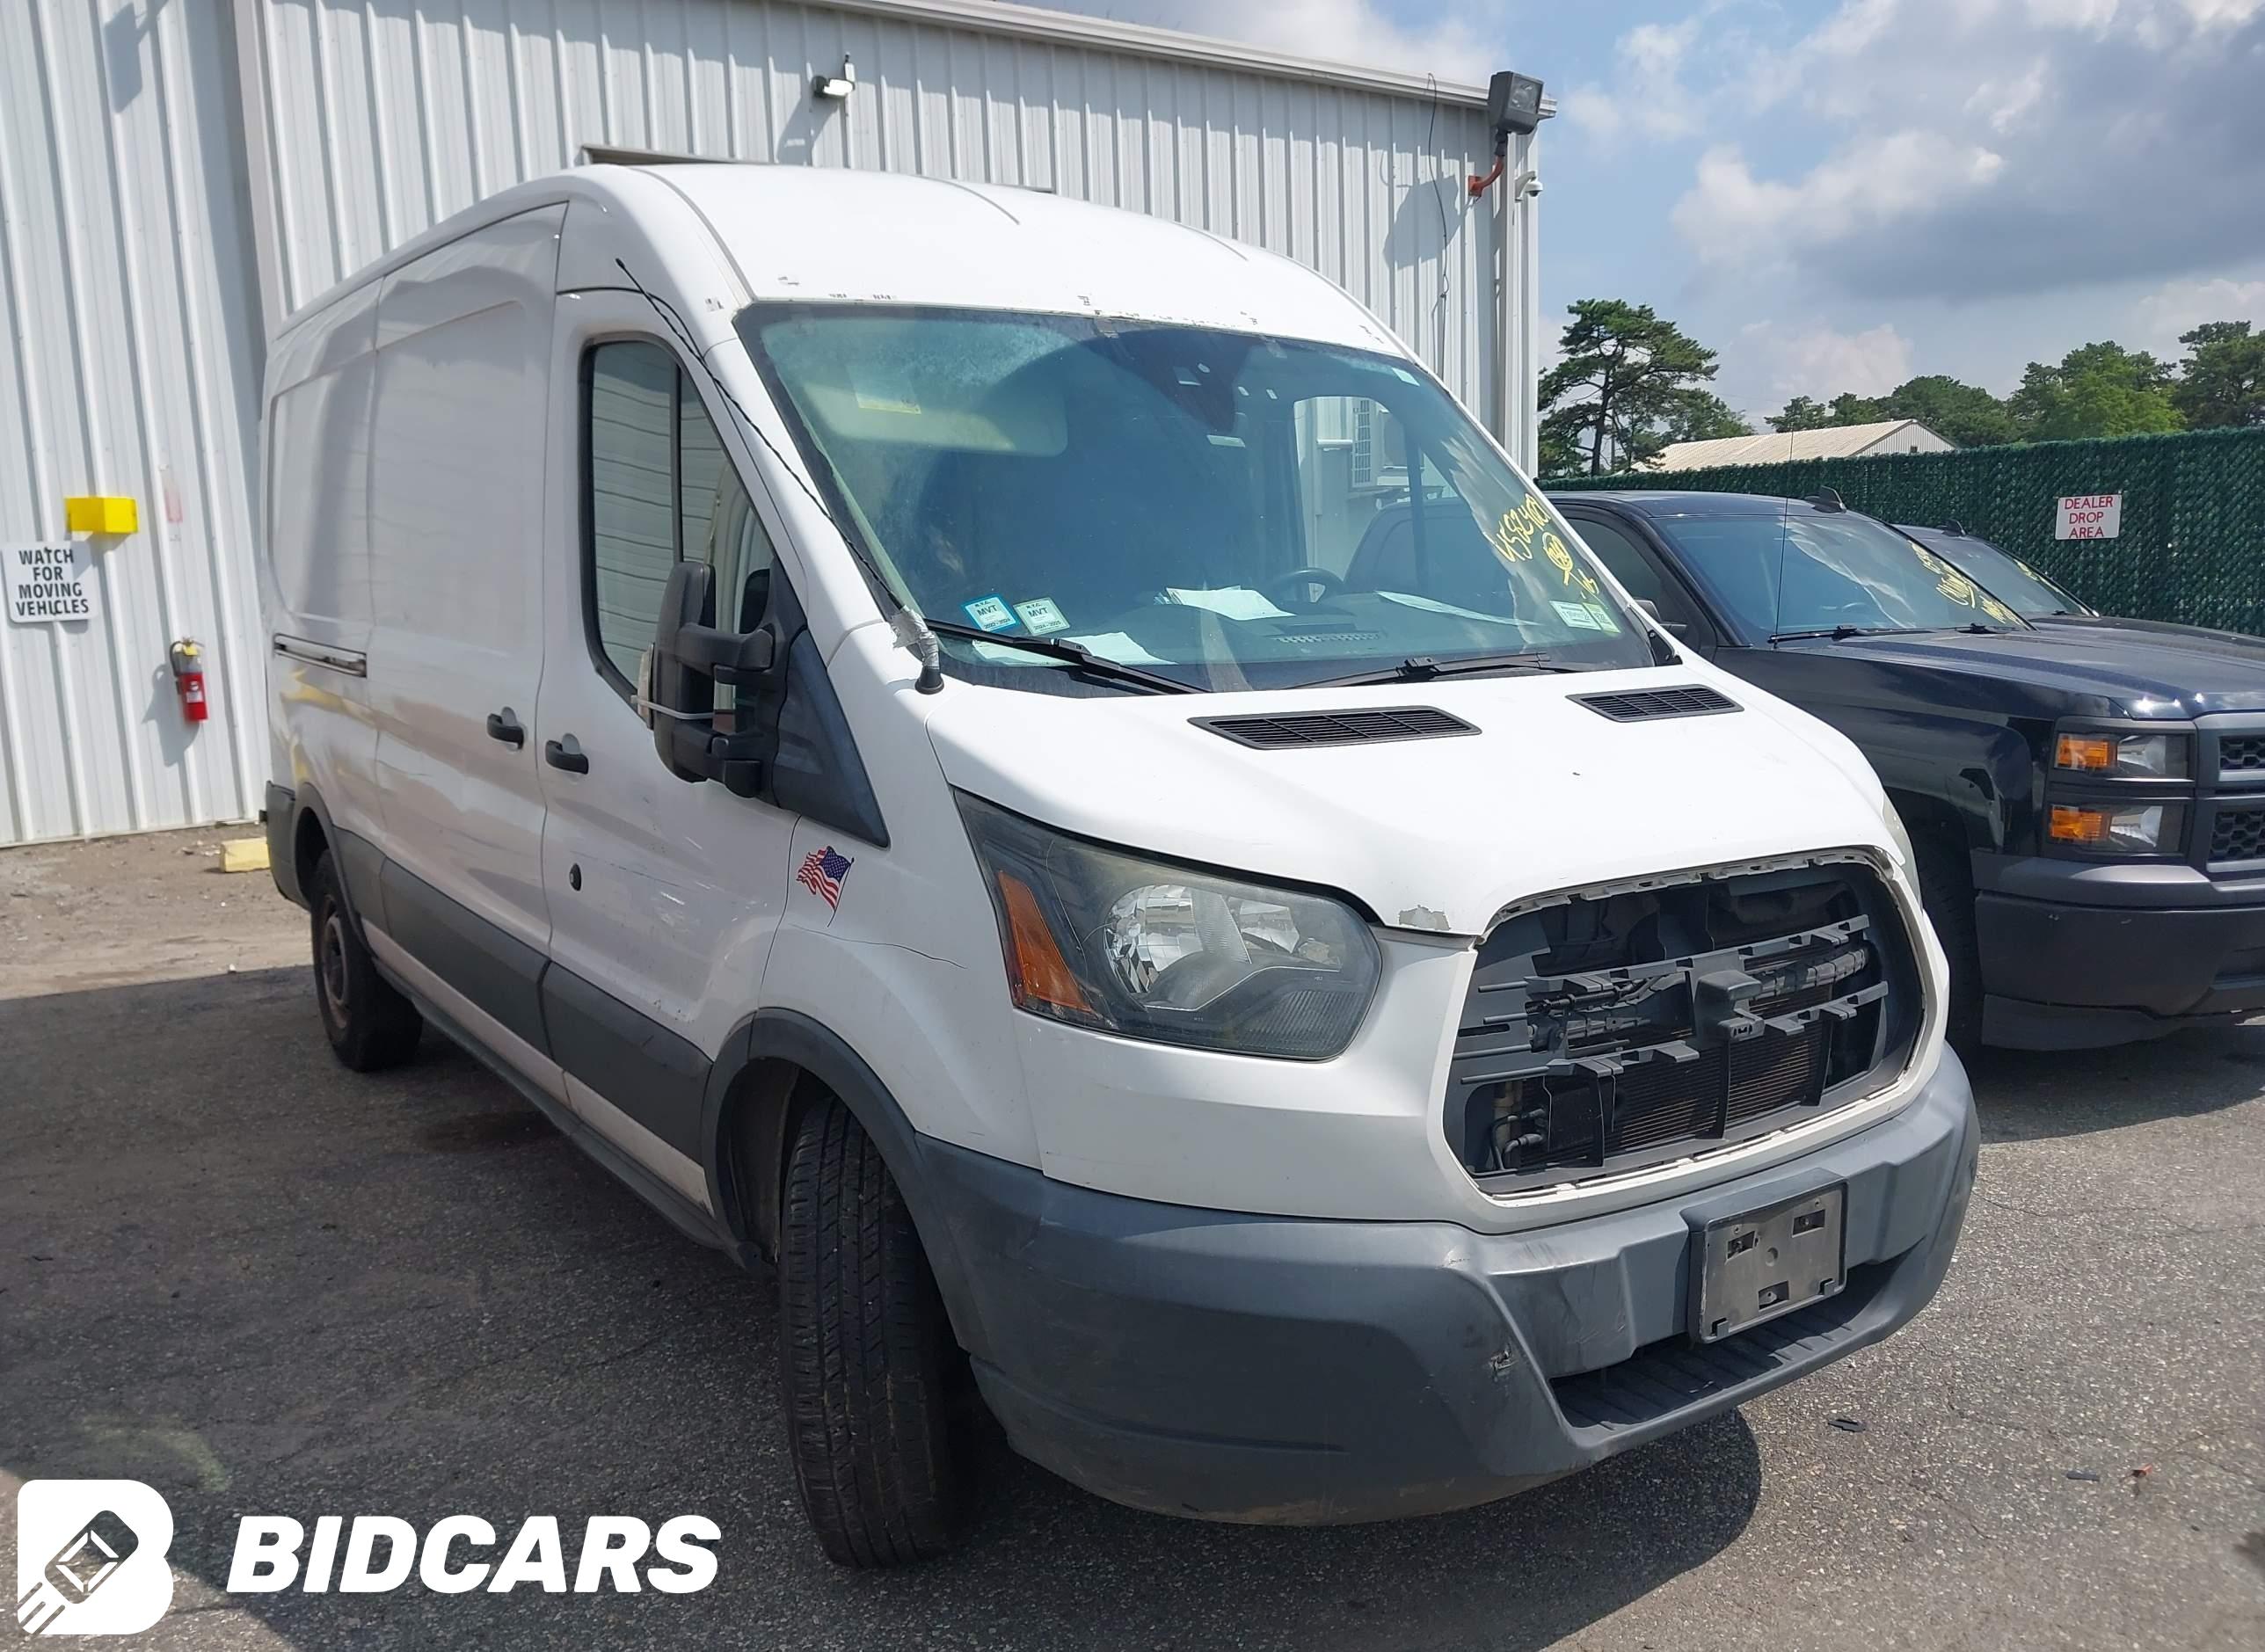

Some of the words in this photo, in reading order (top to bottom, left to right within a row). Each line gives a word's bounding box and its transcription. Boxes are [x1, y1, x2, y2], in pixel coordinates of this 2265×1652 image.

[2065, 496, 2113, 509] DEALER
[2069, 512, 2104, 524] DROP
[2069, 527, 2104, 538] AREA
[18, 548, 74, 564] WATCH
[33, 565, 63, 581] FOR
[18, 582, 83, 599] MOVING
[15, 598, 90, 616] VEHICLES
[976, 604, 998, 616] MVT
[1028, 607, 1049, 618] MVT
